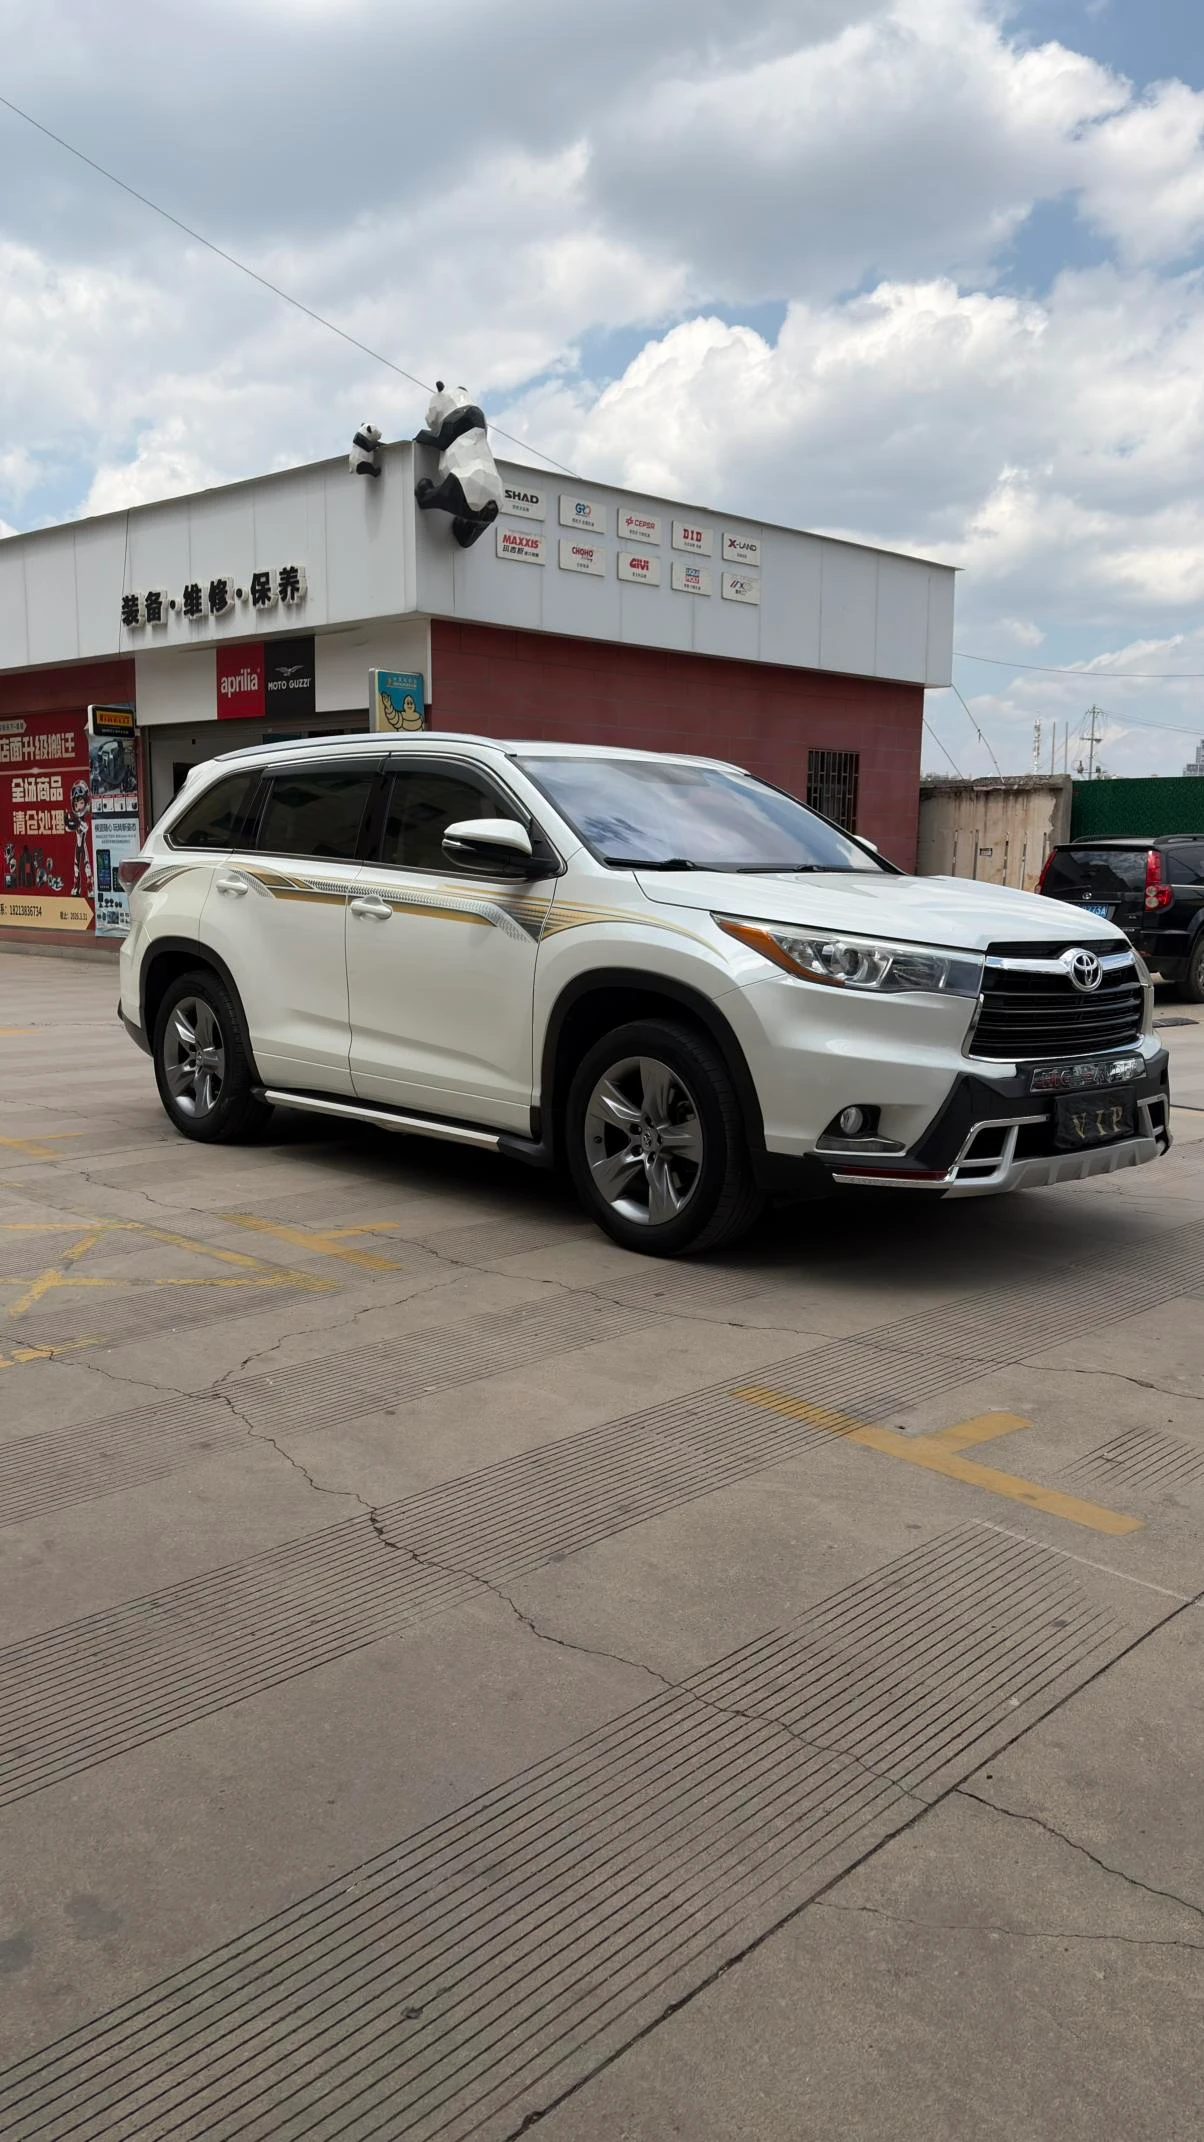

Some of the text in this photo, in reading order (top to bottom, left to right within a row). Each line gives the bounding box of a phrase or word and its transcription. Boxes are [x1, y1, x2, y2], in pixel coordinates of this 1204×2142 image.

[504, 489, 540, 505] SHAD
[575, 502, 592, 517] GRO
[502, 534, 540, 549] MAXXIS
[683, 528, 703, 542] DID
[571, 546, 594, 558] CHOHO
[728, 538, 757, 552] X-LAND
[221, 668, 258, 698] aprilia
[267, 678, 311, 691] MOTO GUZZI
[12, 776, 63, 802] 全场商品
[13, 810, 65, 835] 清仓处理
[1071, 1106, 1124, 1139] VIP
